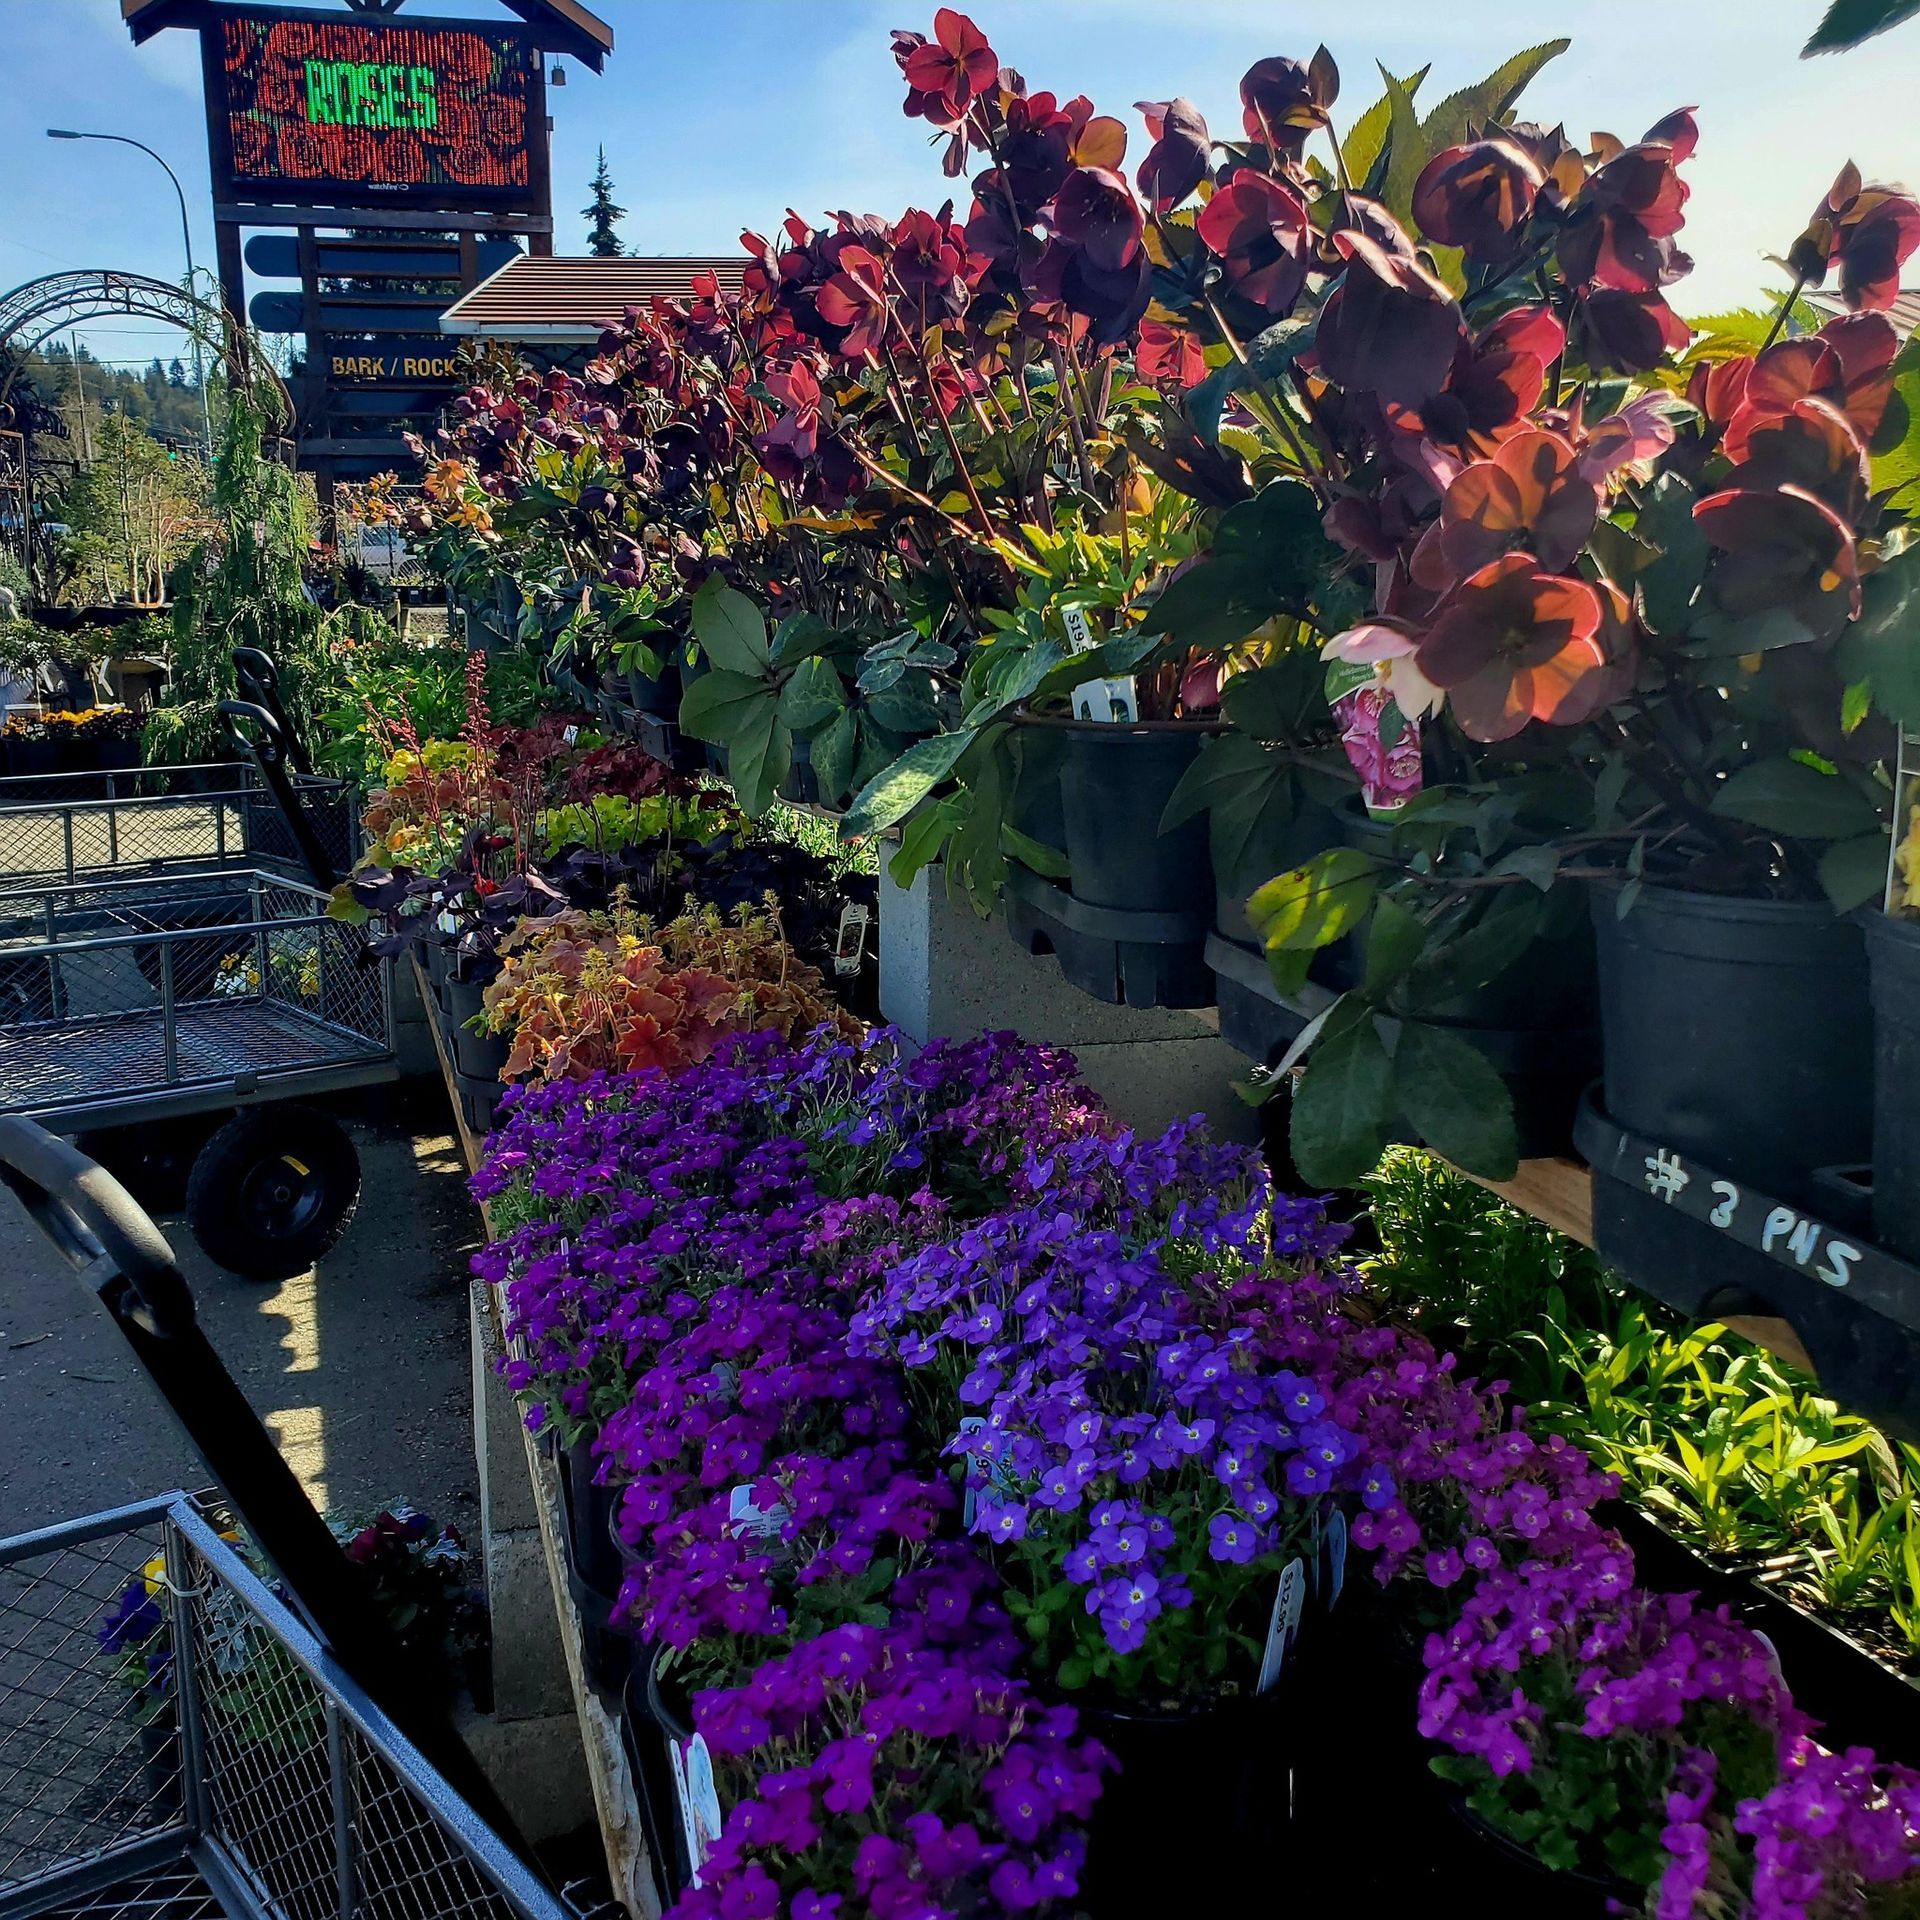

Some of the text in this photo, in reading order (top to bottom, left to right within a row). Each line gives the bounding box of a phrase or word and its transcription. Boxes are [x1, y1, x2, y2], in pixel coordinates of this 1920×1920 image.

[304, 60, 437, 129] ROSES
[332, 356, 458, 377] BARK / ROCK
[1645, 1148, 1864, 1287] # 3 PNS
